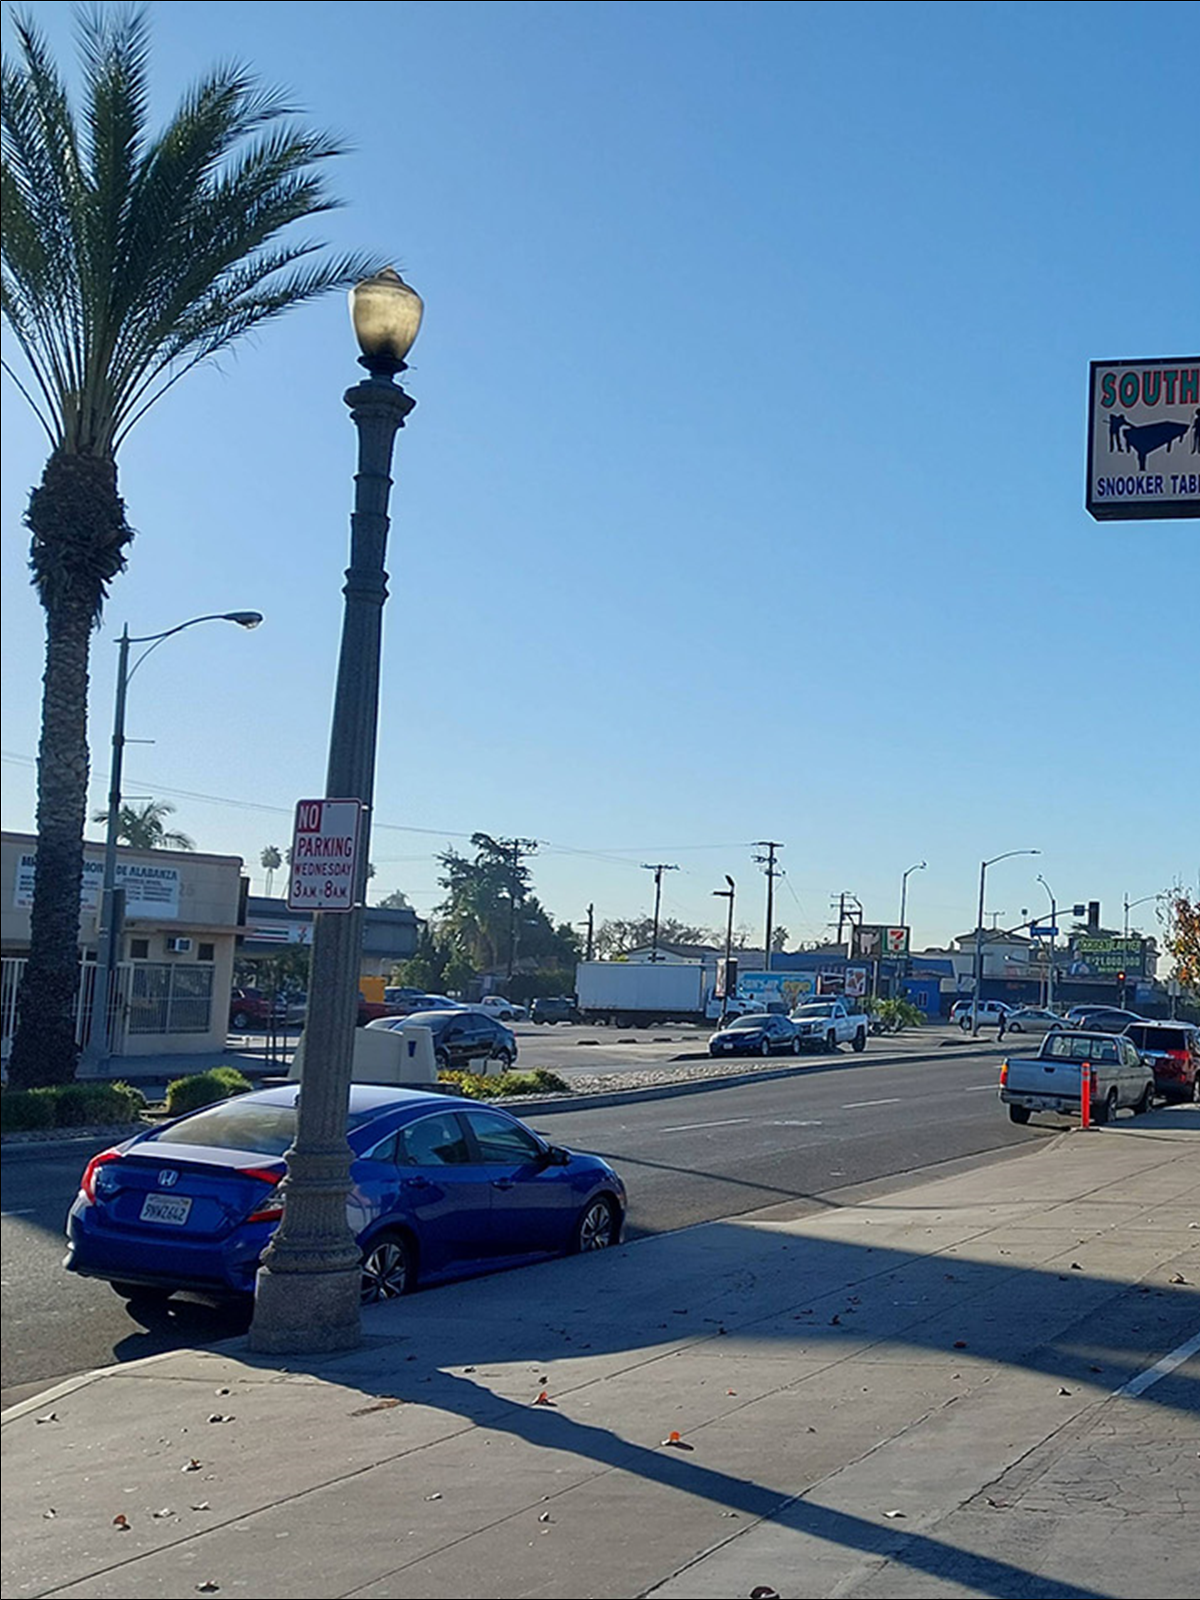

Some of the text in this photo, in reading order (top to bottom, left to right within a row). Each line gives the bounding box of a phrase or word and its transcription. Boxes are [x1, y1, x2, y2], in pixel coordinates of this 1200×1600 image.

[1100, 369, 1200, 407] SOUTH
[1097, 475, 1163, 497] SNOOKER
[298, 804, 320, 830] NO
[297, 837, 353, 858] PARKING
[294, 862, 352, 877] WEDNESDAY
